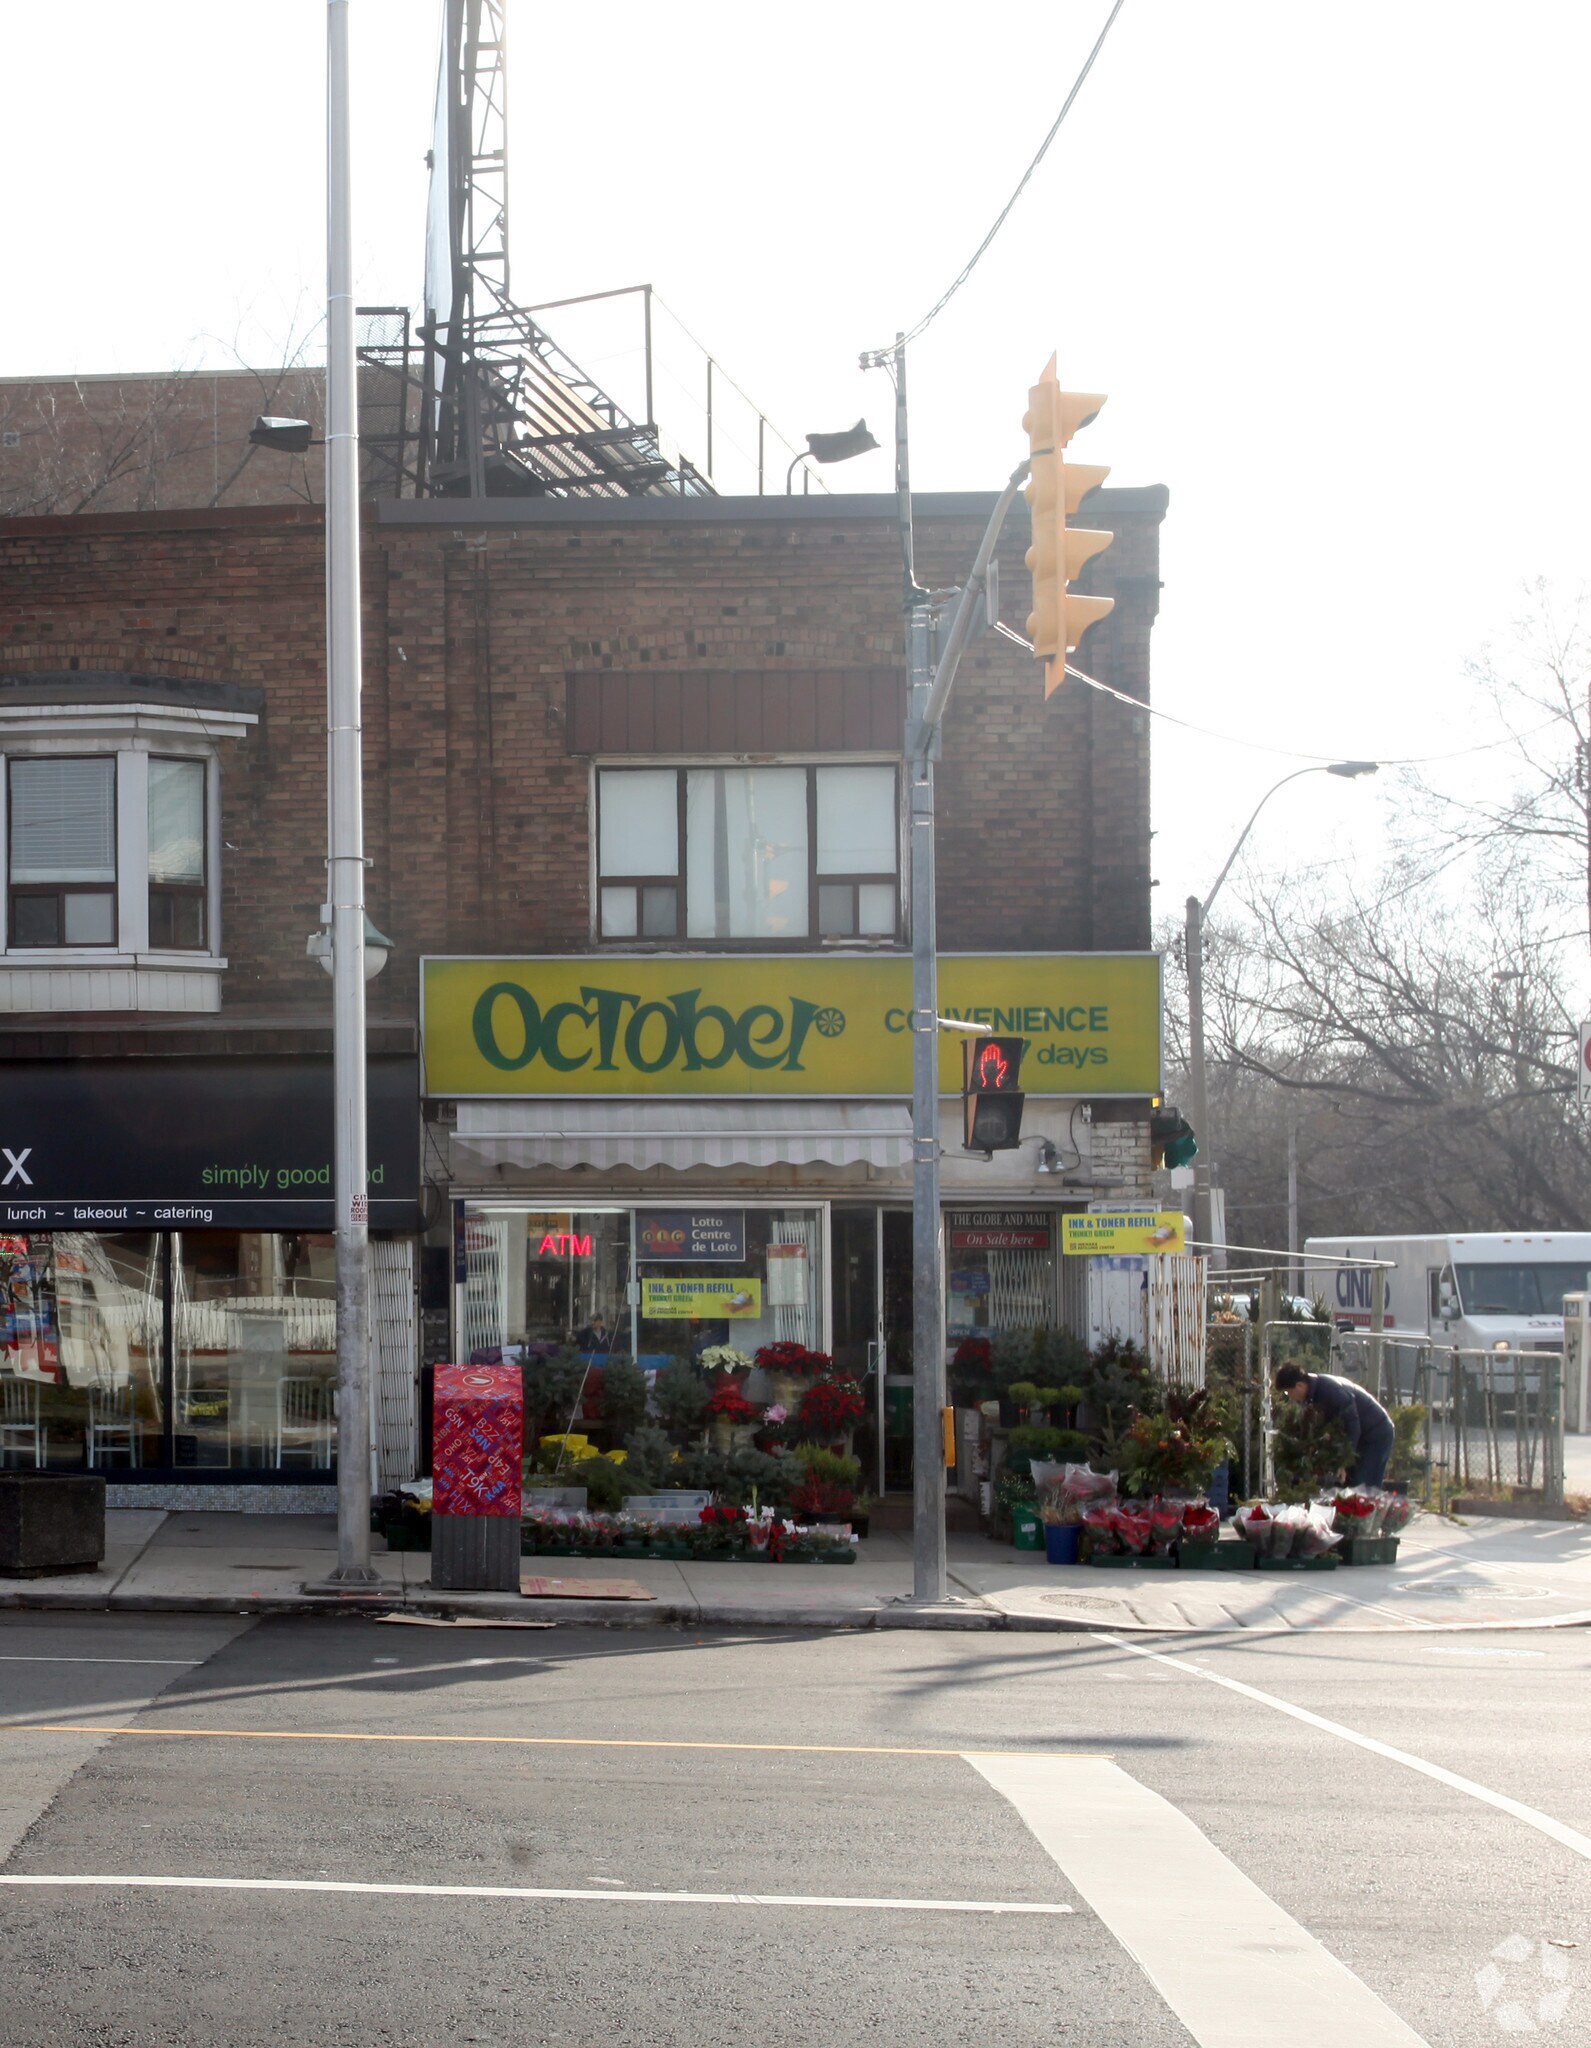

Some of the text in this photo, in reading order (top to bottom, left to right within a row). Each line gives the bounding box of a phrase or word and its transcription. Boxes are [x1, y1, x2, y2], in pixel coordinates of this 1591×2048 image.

[472, 982, 821, 1073] October
[884, 1006, 1109, 1032] CVENIENCE
[1037, 1043, 1108, 1069] days
[202, 1164, 330, 1189] simply good
[7, 1207, 46, 1220] lunch
[74, 1207, 128, 1220] takeout
[154, 1206, 213, 1222] catering
[691, 1217, 723, 1227] Lotto
[953, 1213, 1049, 1226] THE GLOBE AND MAIL
[1068, 1216, 1157, 1229] INK & TONER REFILL
[691, 1229, 731, 1240] Centre
[966, 1232, 1034, 1245] On Sale here
[539, 1234, 592, 1256] ATM
[691, 1241, 737, 1252] de Loto
[648, 1283, 734, 1293] INK & TONER REFILL
[445, 1408, 465, 1428] G5N
[469, 1427, 491, 1450] S4N
[476, 1417, 500, 1442] B2Z
[463, 1467, 489, 1497] T9K
[485, 1480, 507, 1500] K4A
